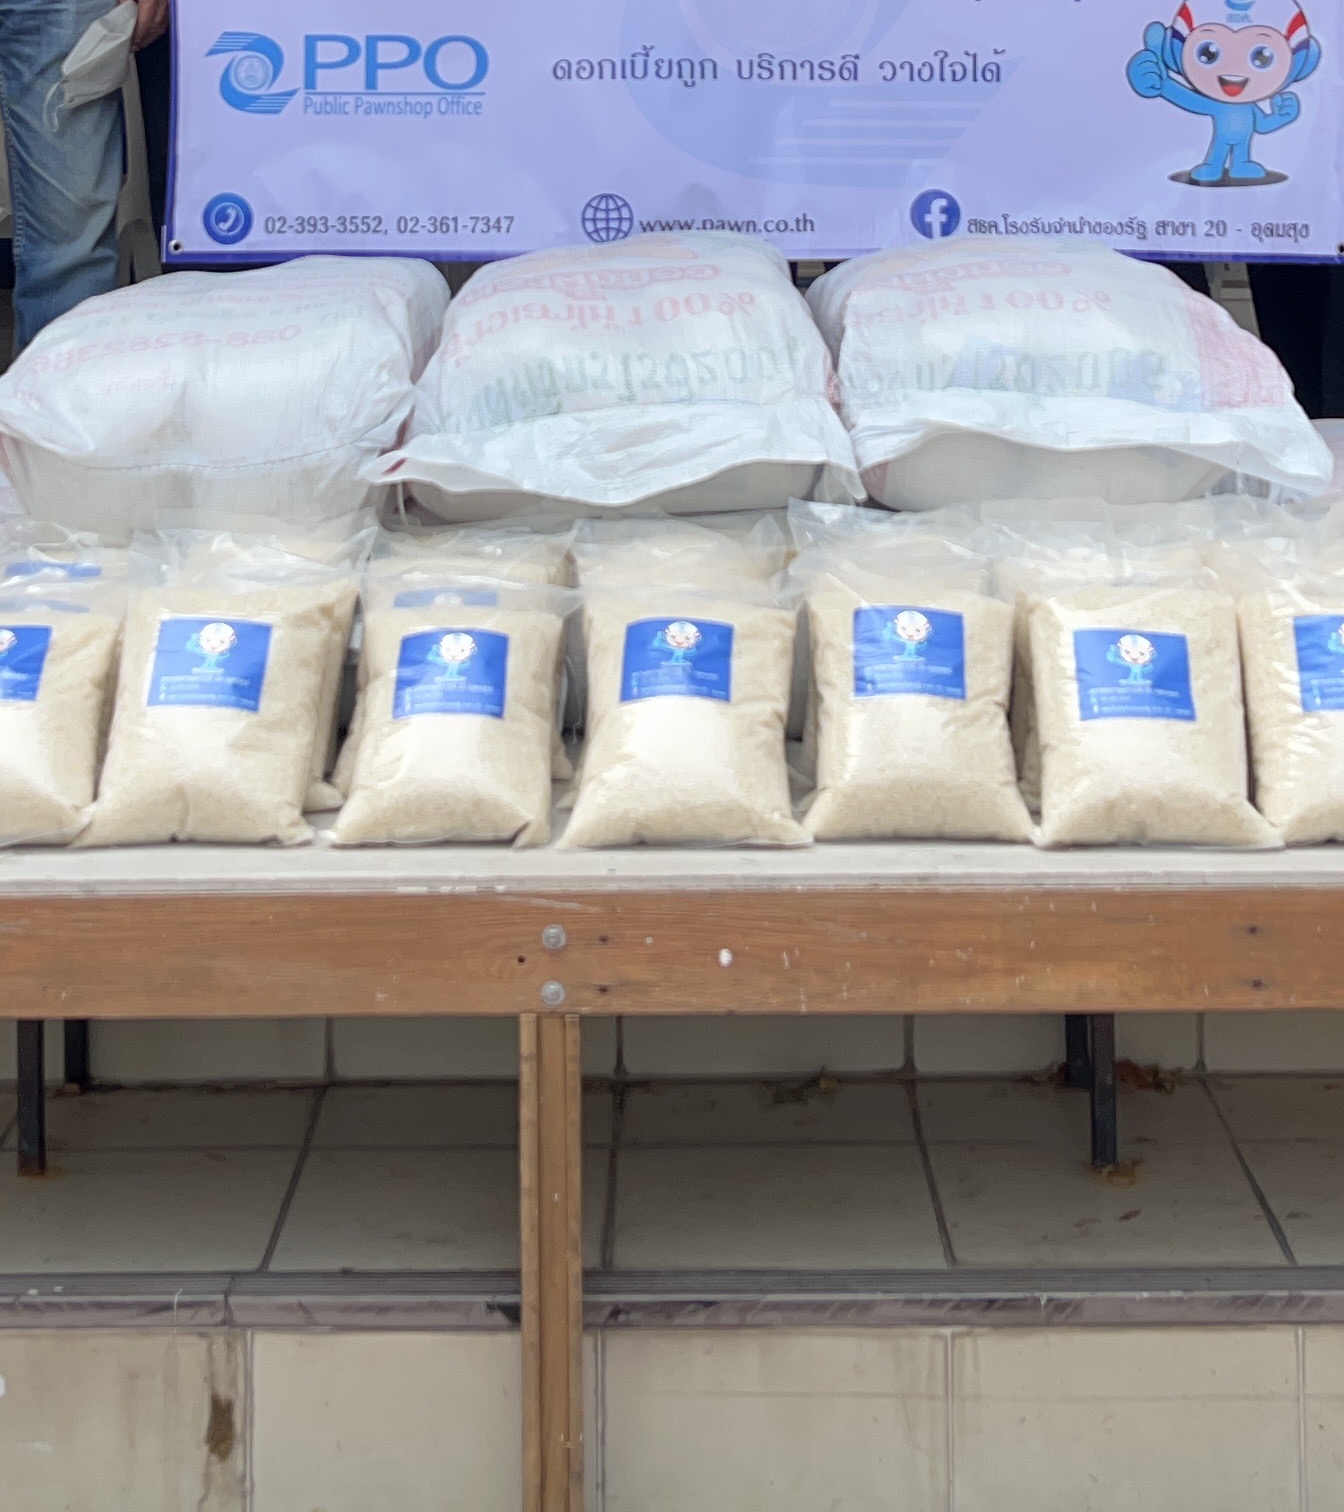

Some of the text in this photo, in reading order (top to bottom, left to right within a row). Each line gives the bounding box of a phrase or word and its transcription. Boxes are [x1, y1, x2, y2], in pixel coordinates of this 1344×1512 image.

[303, 34, 489, 90] PPO
[552, 45, 1006, 88] ดอกเบี้ยถูก บริการดี วางใจได้
[304, 96, 483, 119] Public Pawnshop Office
[264, 216, 515, 236] 02-393-3552, 02-361-7347
[1155, 220, 1196, 237] สาขา
[1204, 220, 1227, 238] 20
[1251, 222, 1311, 244] อุดมสุข
